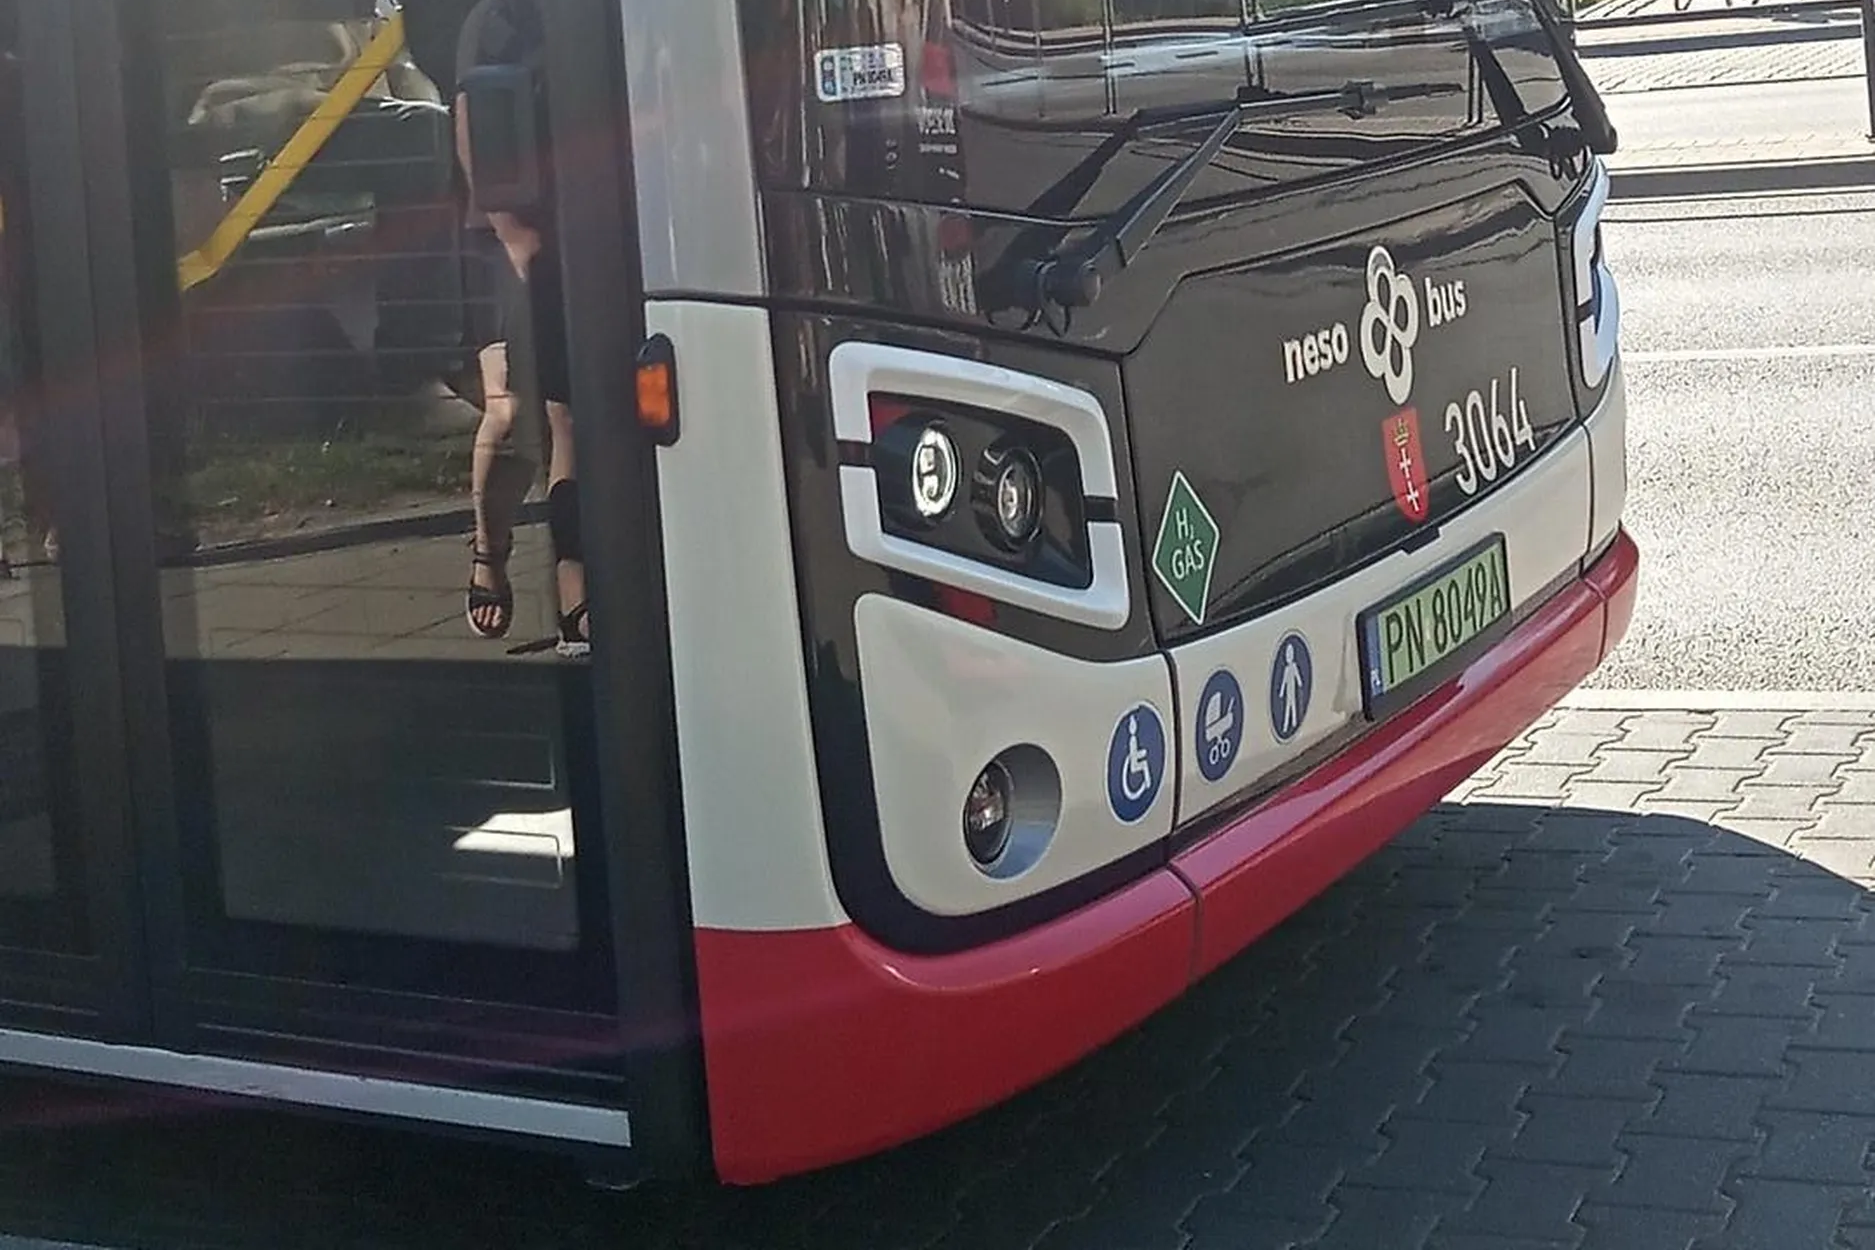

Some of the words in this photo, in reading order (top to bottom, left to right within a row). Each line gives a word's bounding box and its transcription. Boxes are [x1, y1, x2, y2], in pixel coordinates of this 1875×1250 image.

[1283, 322, 1349, 383] neso
[1424, 276, 1467, 327] bus
[1445, 367, 1536, 495] 3064
[1171, 539, 1205, 579] GAS
[1385, 598, 1425, 684] PN
[1432, 552, 1503, 654] 8049A
